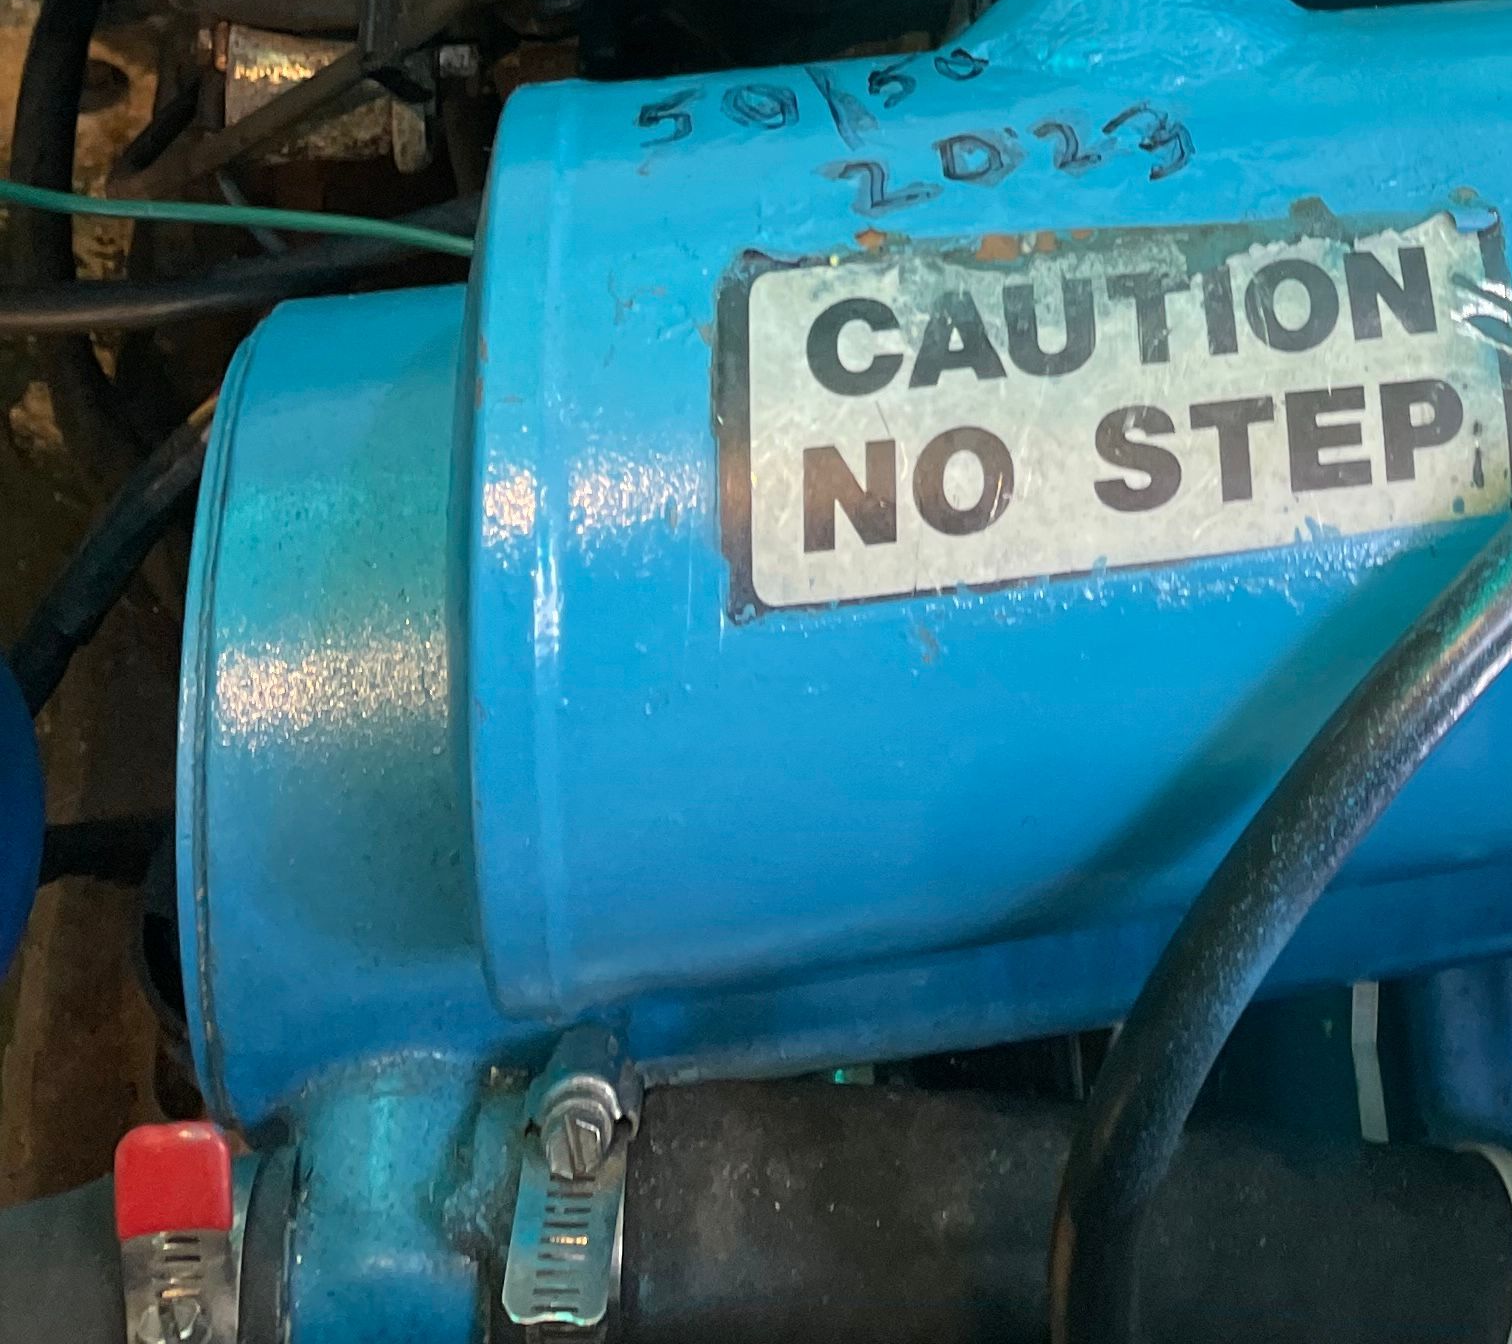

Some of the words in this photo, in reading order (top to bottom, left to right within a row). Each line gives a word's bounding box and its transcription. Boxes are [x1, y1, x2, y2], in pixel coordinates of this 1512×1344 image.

[828, 100, 1198, 217] 2023
[805, 246, 1439, 399] CAUTION
[801, 422, 1016, 554] NO
[1092, 377, 1465, 513] STEP
